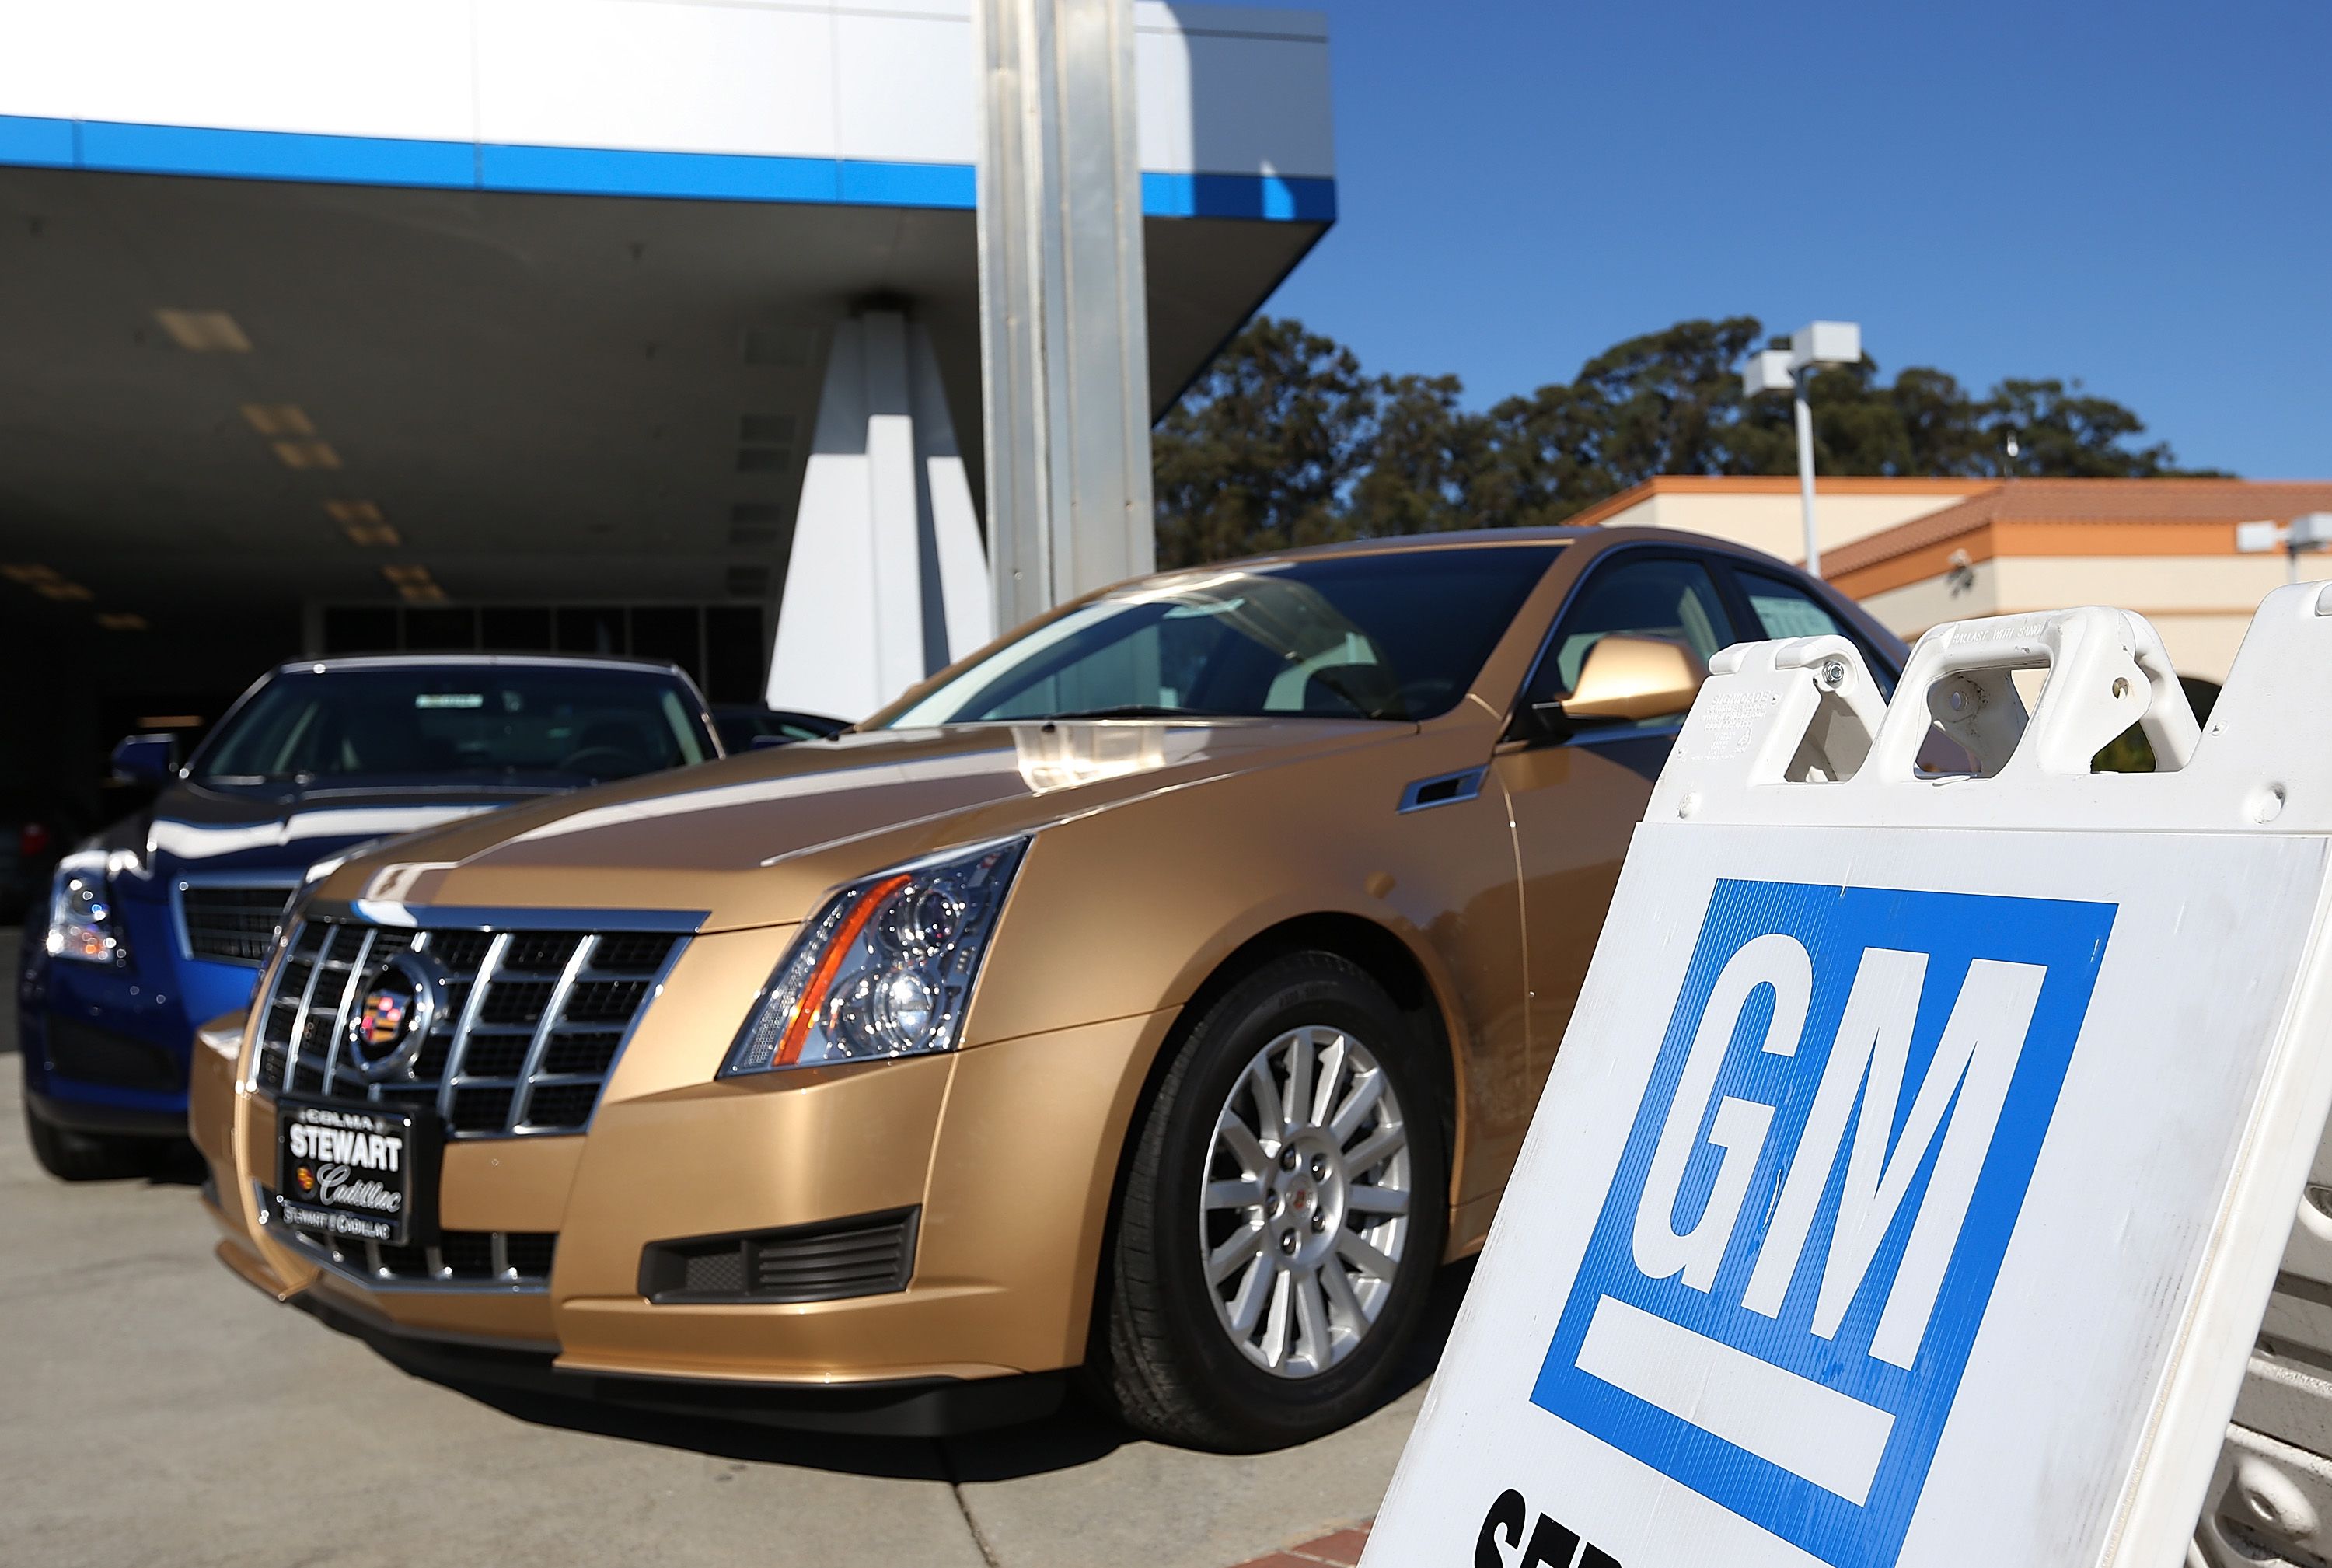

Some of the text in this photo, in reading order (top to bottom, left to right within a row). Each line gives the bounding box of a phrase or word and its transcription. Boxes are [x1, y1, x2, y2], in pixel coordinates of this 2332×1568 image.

[1952, 623, 2043, 644] BALLAST WITH SAND
[1712, 690, 1770, 705] SIGNICADE
[290, 1123, 403, 1172] STEWART
[1632, 933, 2047, 1371] GM
[316, 1163, 403, 1213] Cadillac
